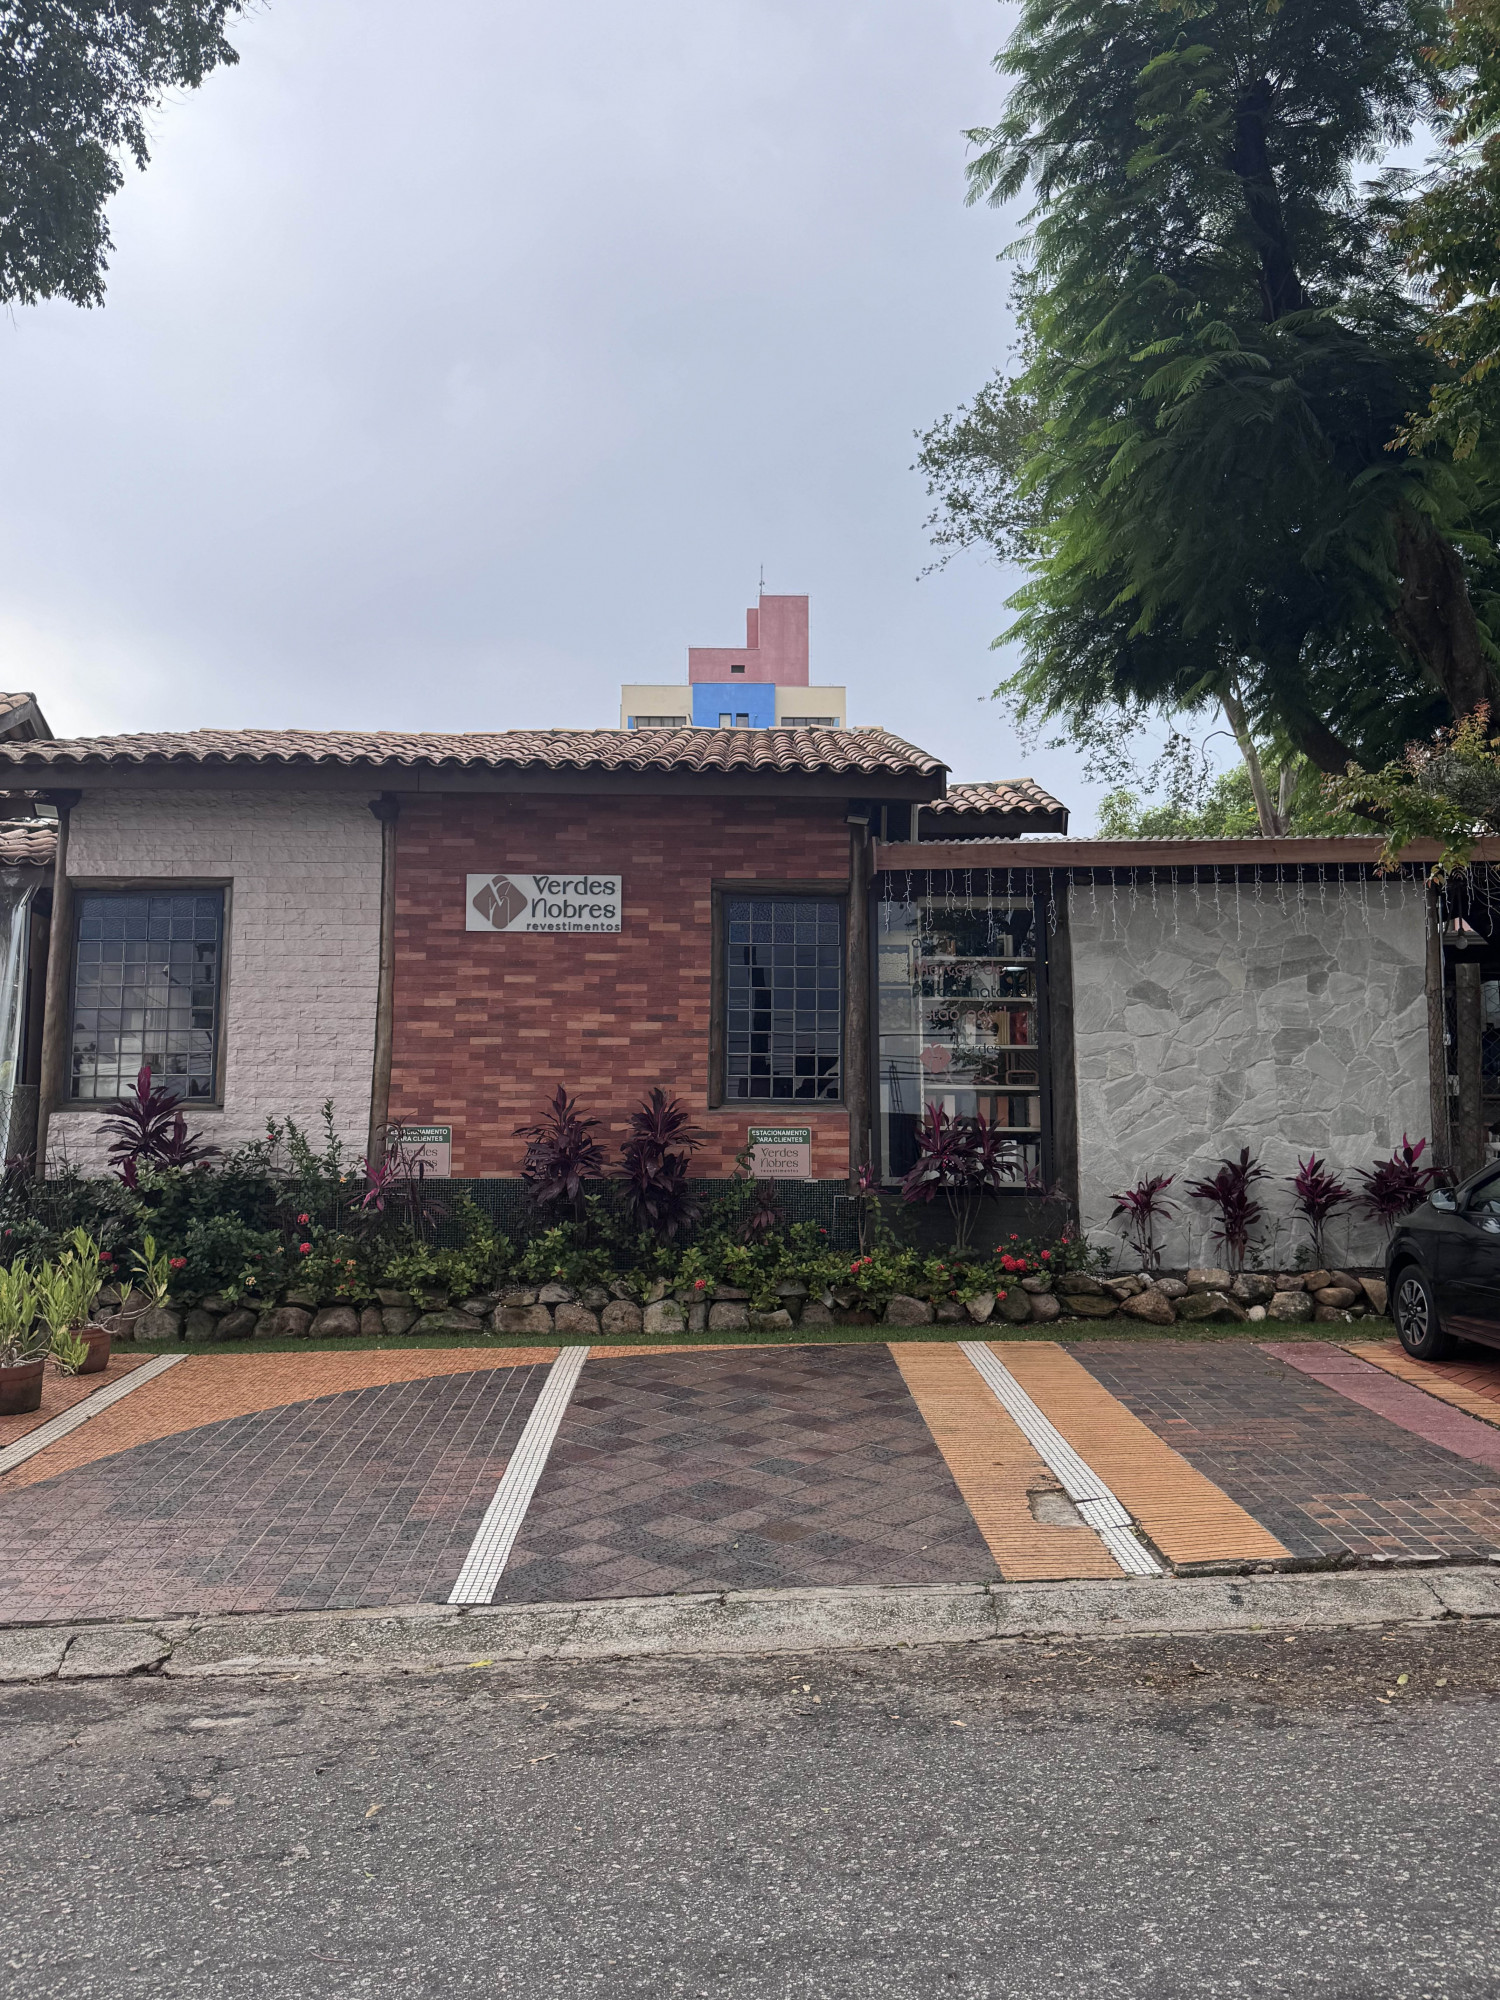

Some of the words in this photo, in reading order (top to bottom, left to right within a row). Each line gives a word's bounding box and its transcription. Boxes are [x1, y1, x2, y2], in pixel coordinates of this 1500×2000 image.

[532, 875, 616, 896] Verdes
[531, 897, 616, 919] Nobres
[526, 921, 621, 932] revestimentos
[761, 1148, 799, 1158] Verdes
